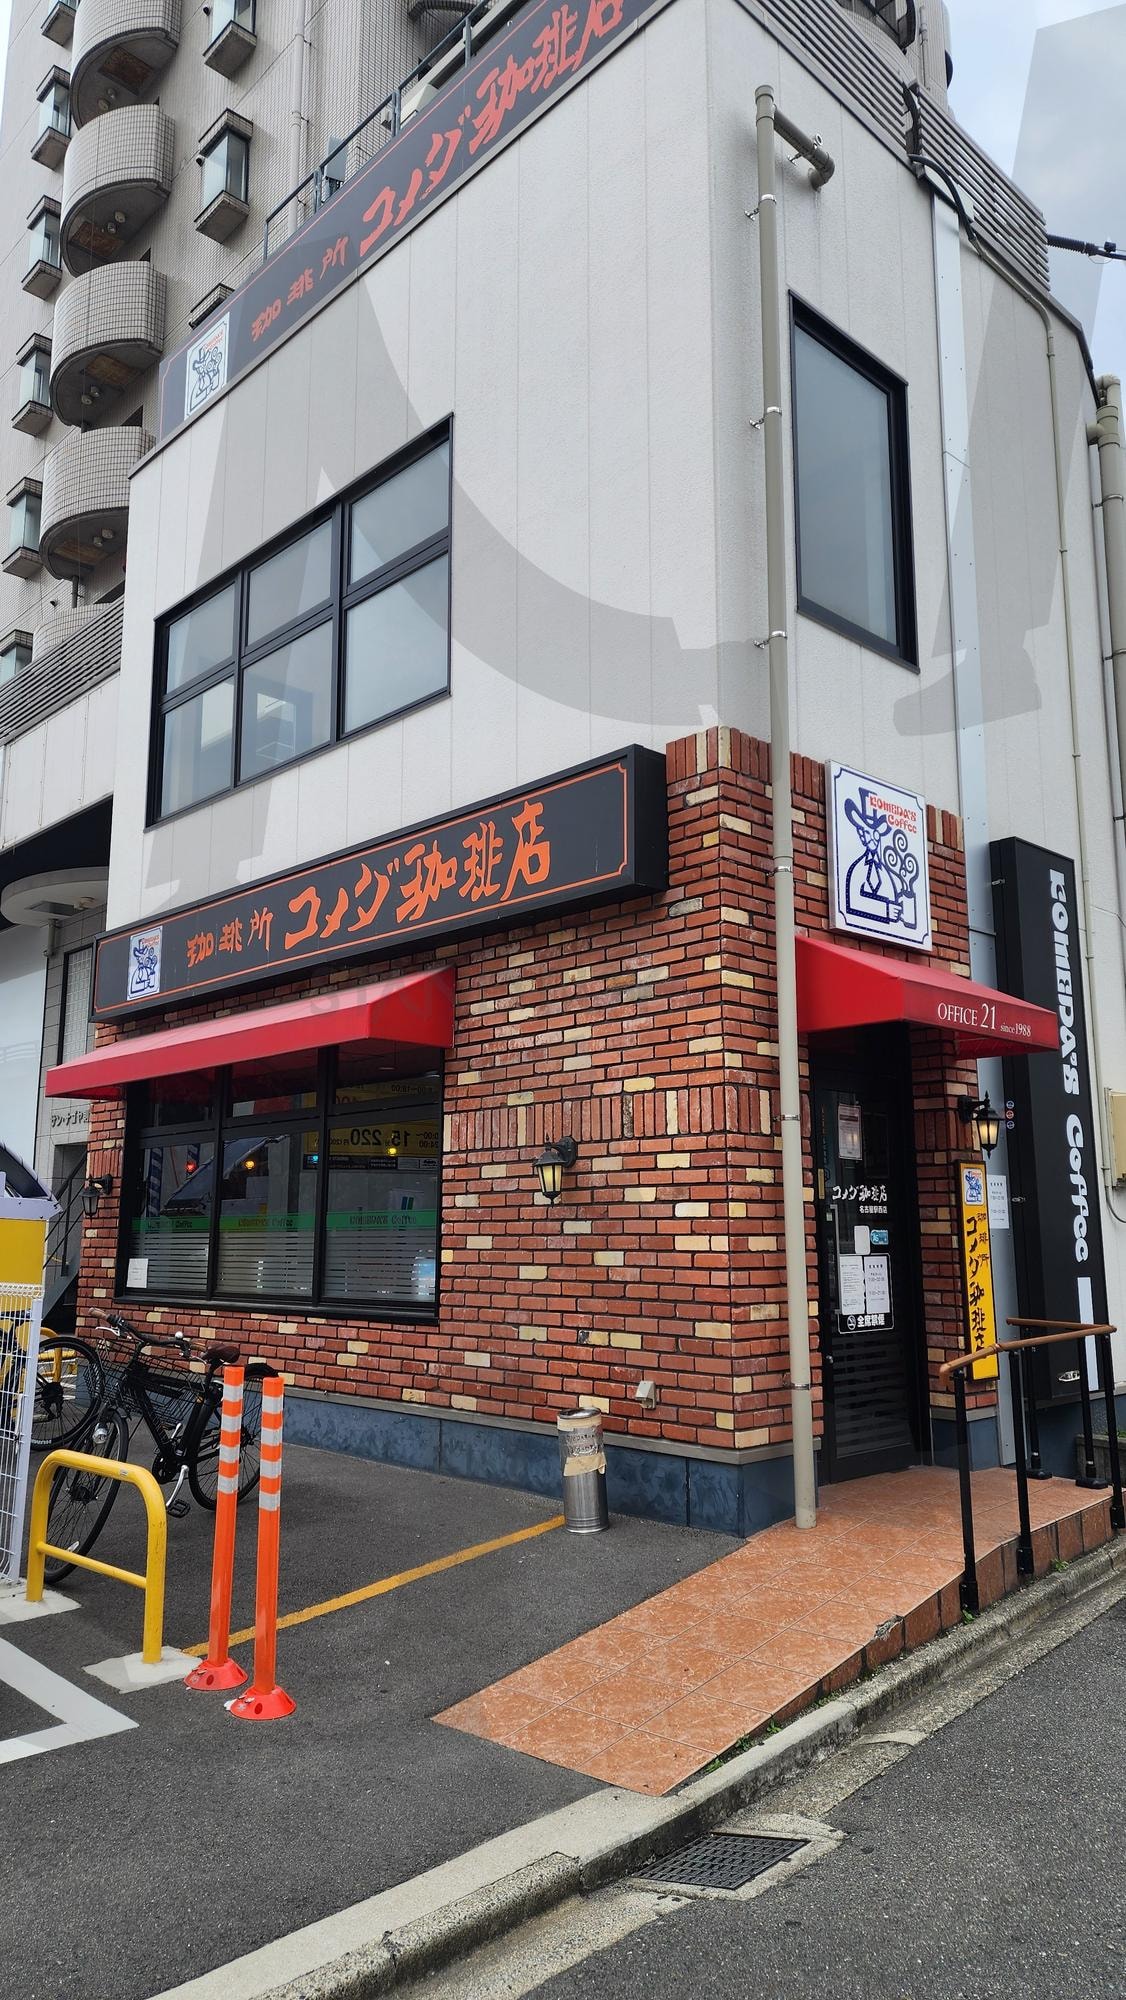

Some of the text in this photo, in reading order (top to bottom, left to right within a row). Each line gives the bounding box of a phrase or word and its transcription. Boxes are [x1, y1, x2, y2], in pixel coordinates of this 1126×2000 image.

[887, 813, 918, 835] Coffee
[285, 801, 551, 951] コメダ珈琲店
[937, 1002, 978, 1027] OFFICE
[980, 1003, 997, 1031] 21
[1049, 868, 1089, 1264] KOMEDA'S Coffee
[832, 1184, 888, 1203] コメダ珈琲店
[857, 1314, 886, 1328] 全席禁煙
